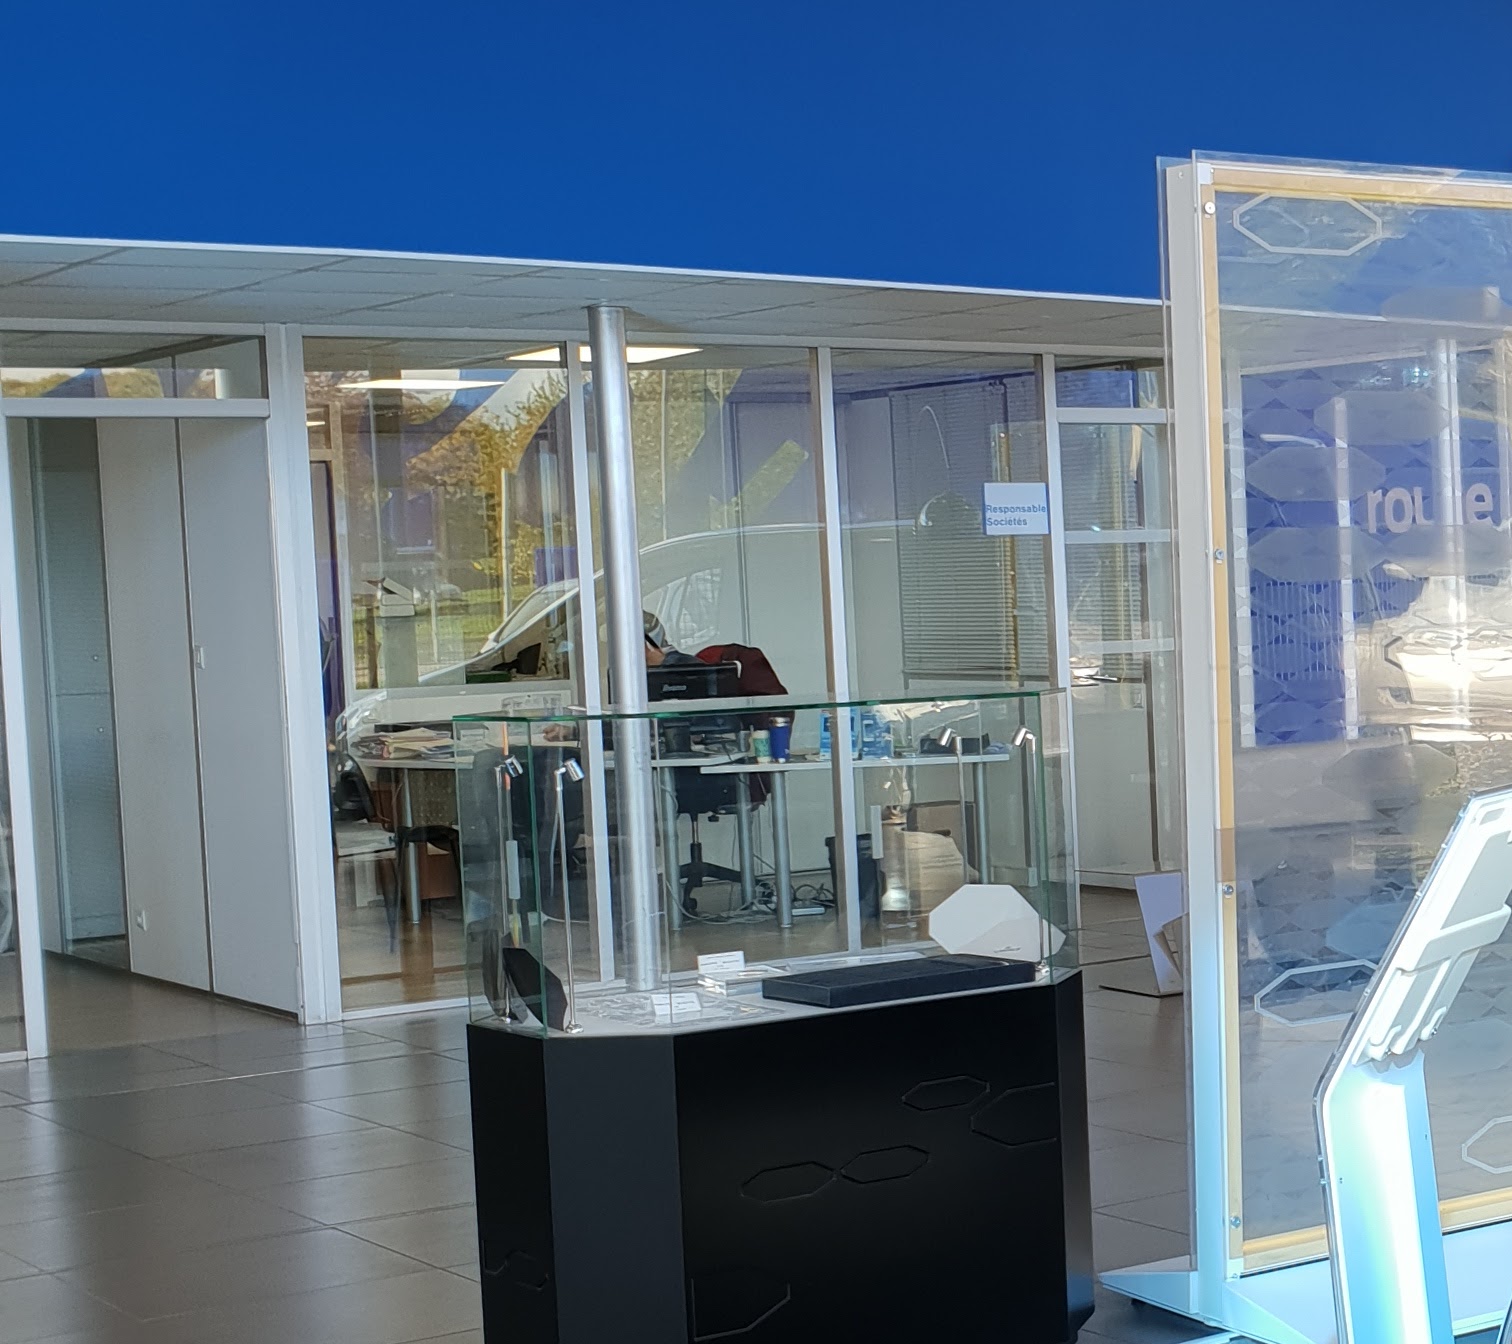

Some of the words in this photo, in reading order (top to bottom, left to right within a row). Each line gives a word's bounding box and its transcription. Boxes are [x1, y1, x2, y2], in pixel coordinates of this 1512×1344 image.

[986, 504, 1047, 515] Responsable
[1366, 483, 1494, 534] roue
[986, 516, 1028, 527] Sociétés
